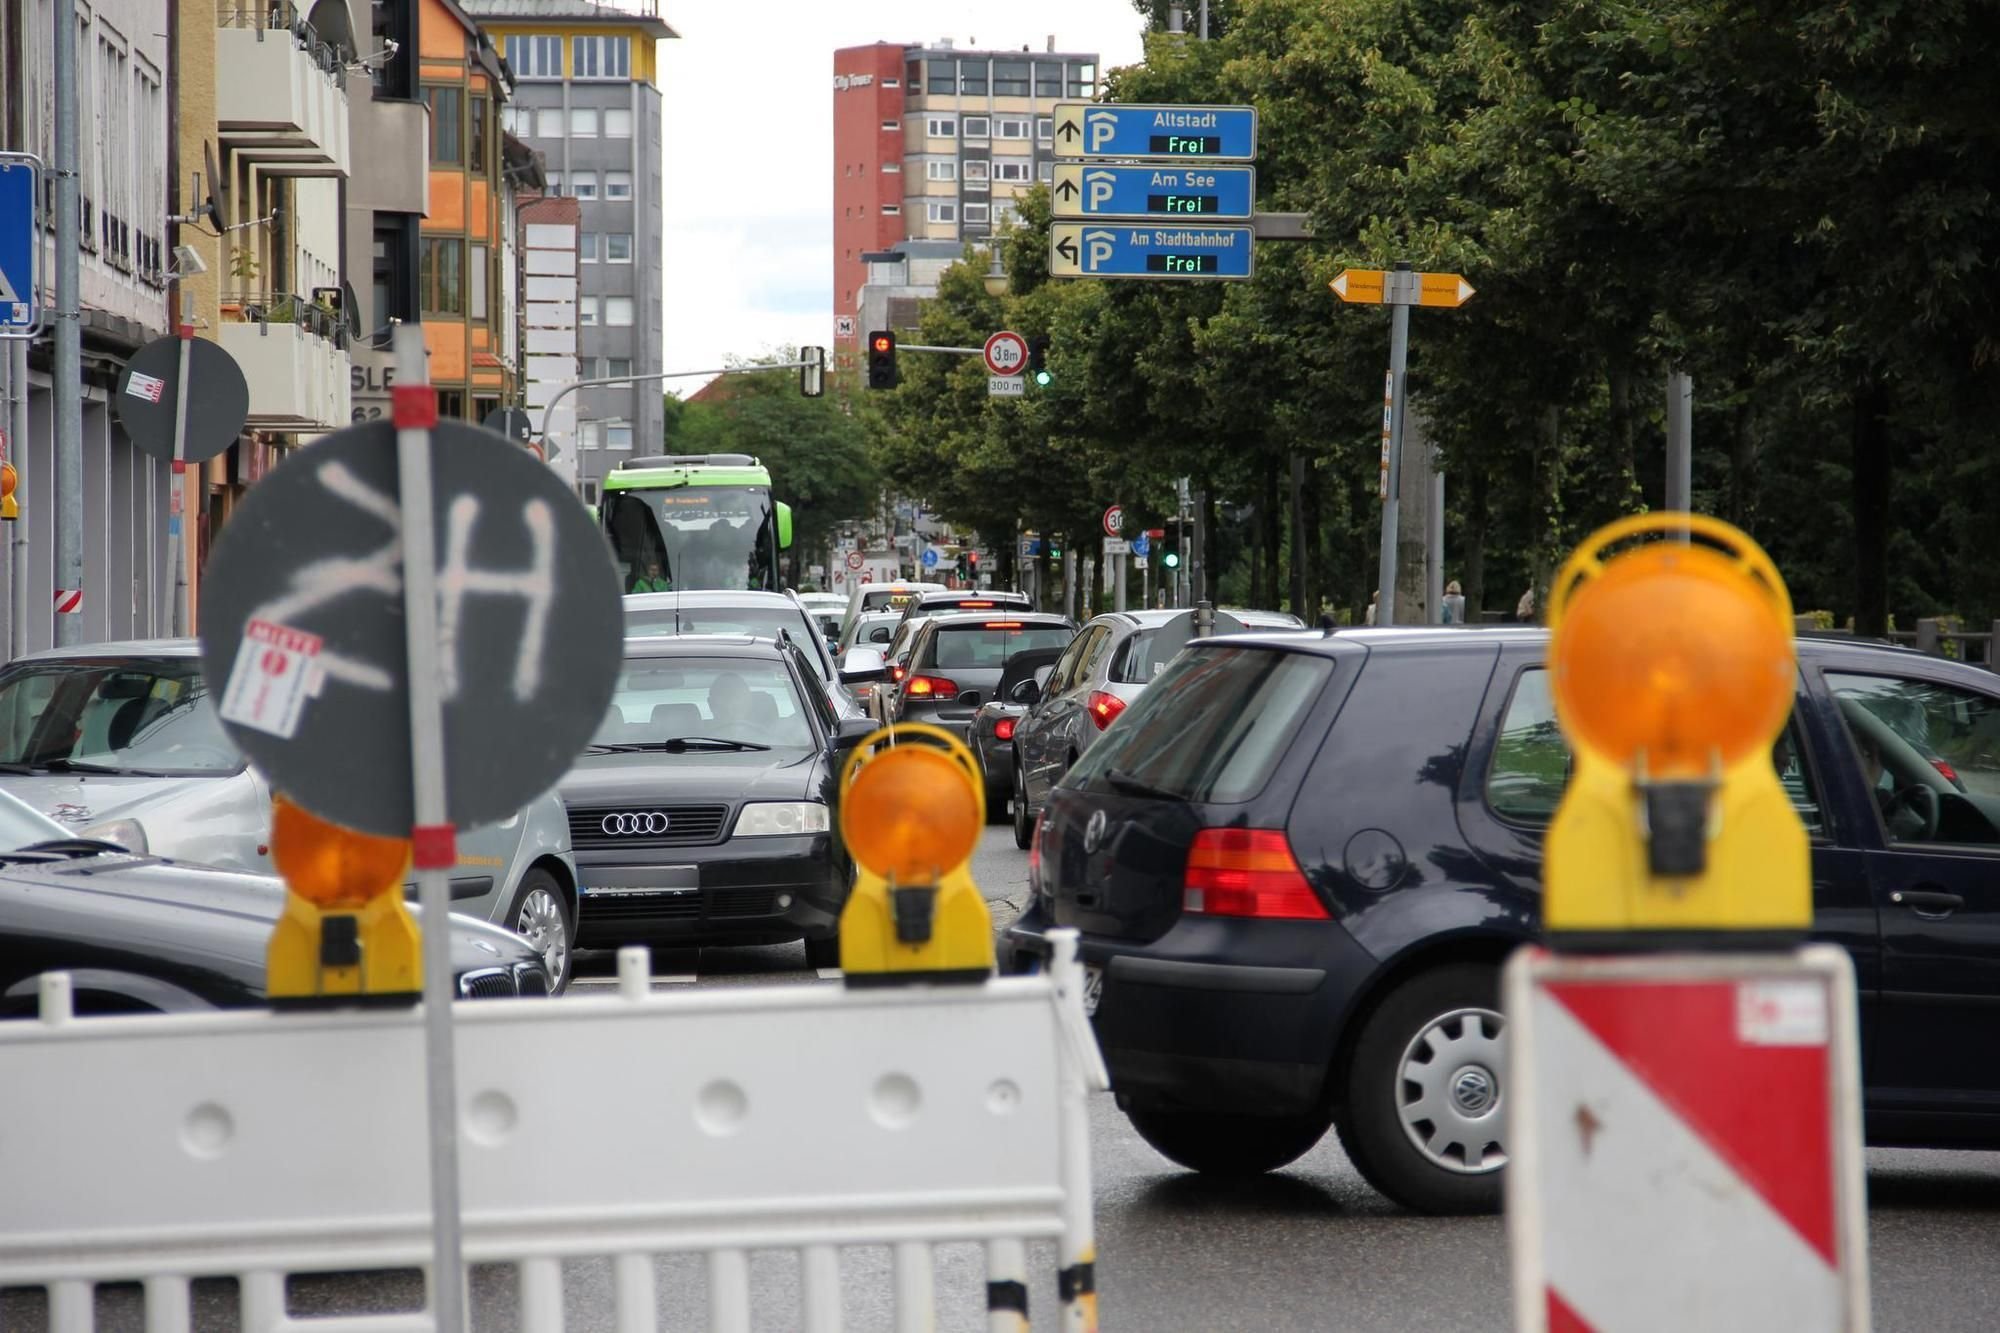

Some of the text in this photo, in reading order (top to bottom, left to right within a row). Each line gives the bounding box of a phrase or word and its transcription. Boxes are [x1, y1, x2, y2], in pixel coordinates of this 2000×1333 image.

[1153, 111, 1217, 128] Altstadt
[1169, 136, 1204, 153] Frei
[1151, 172, 1216, 187] Am See
[1167, 196, 1202, 213] Frei
[1130, 231, 1235, 248] Am Stadtbahnhof
[1166, 255, 1201, 272] Frei
[1349, 282, 1383, 293] Wanderweg
[1423, 285, 1457, 296] Wanderweg
[991, 381, 1022, 391] 300 m
